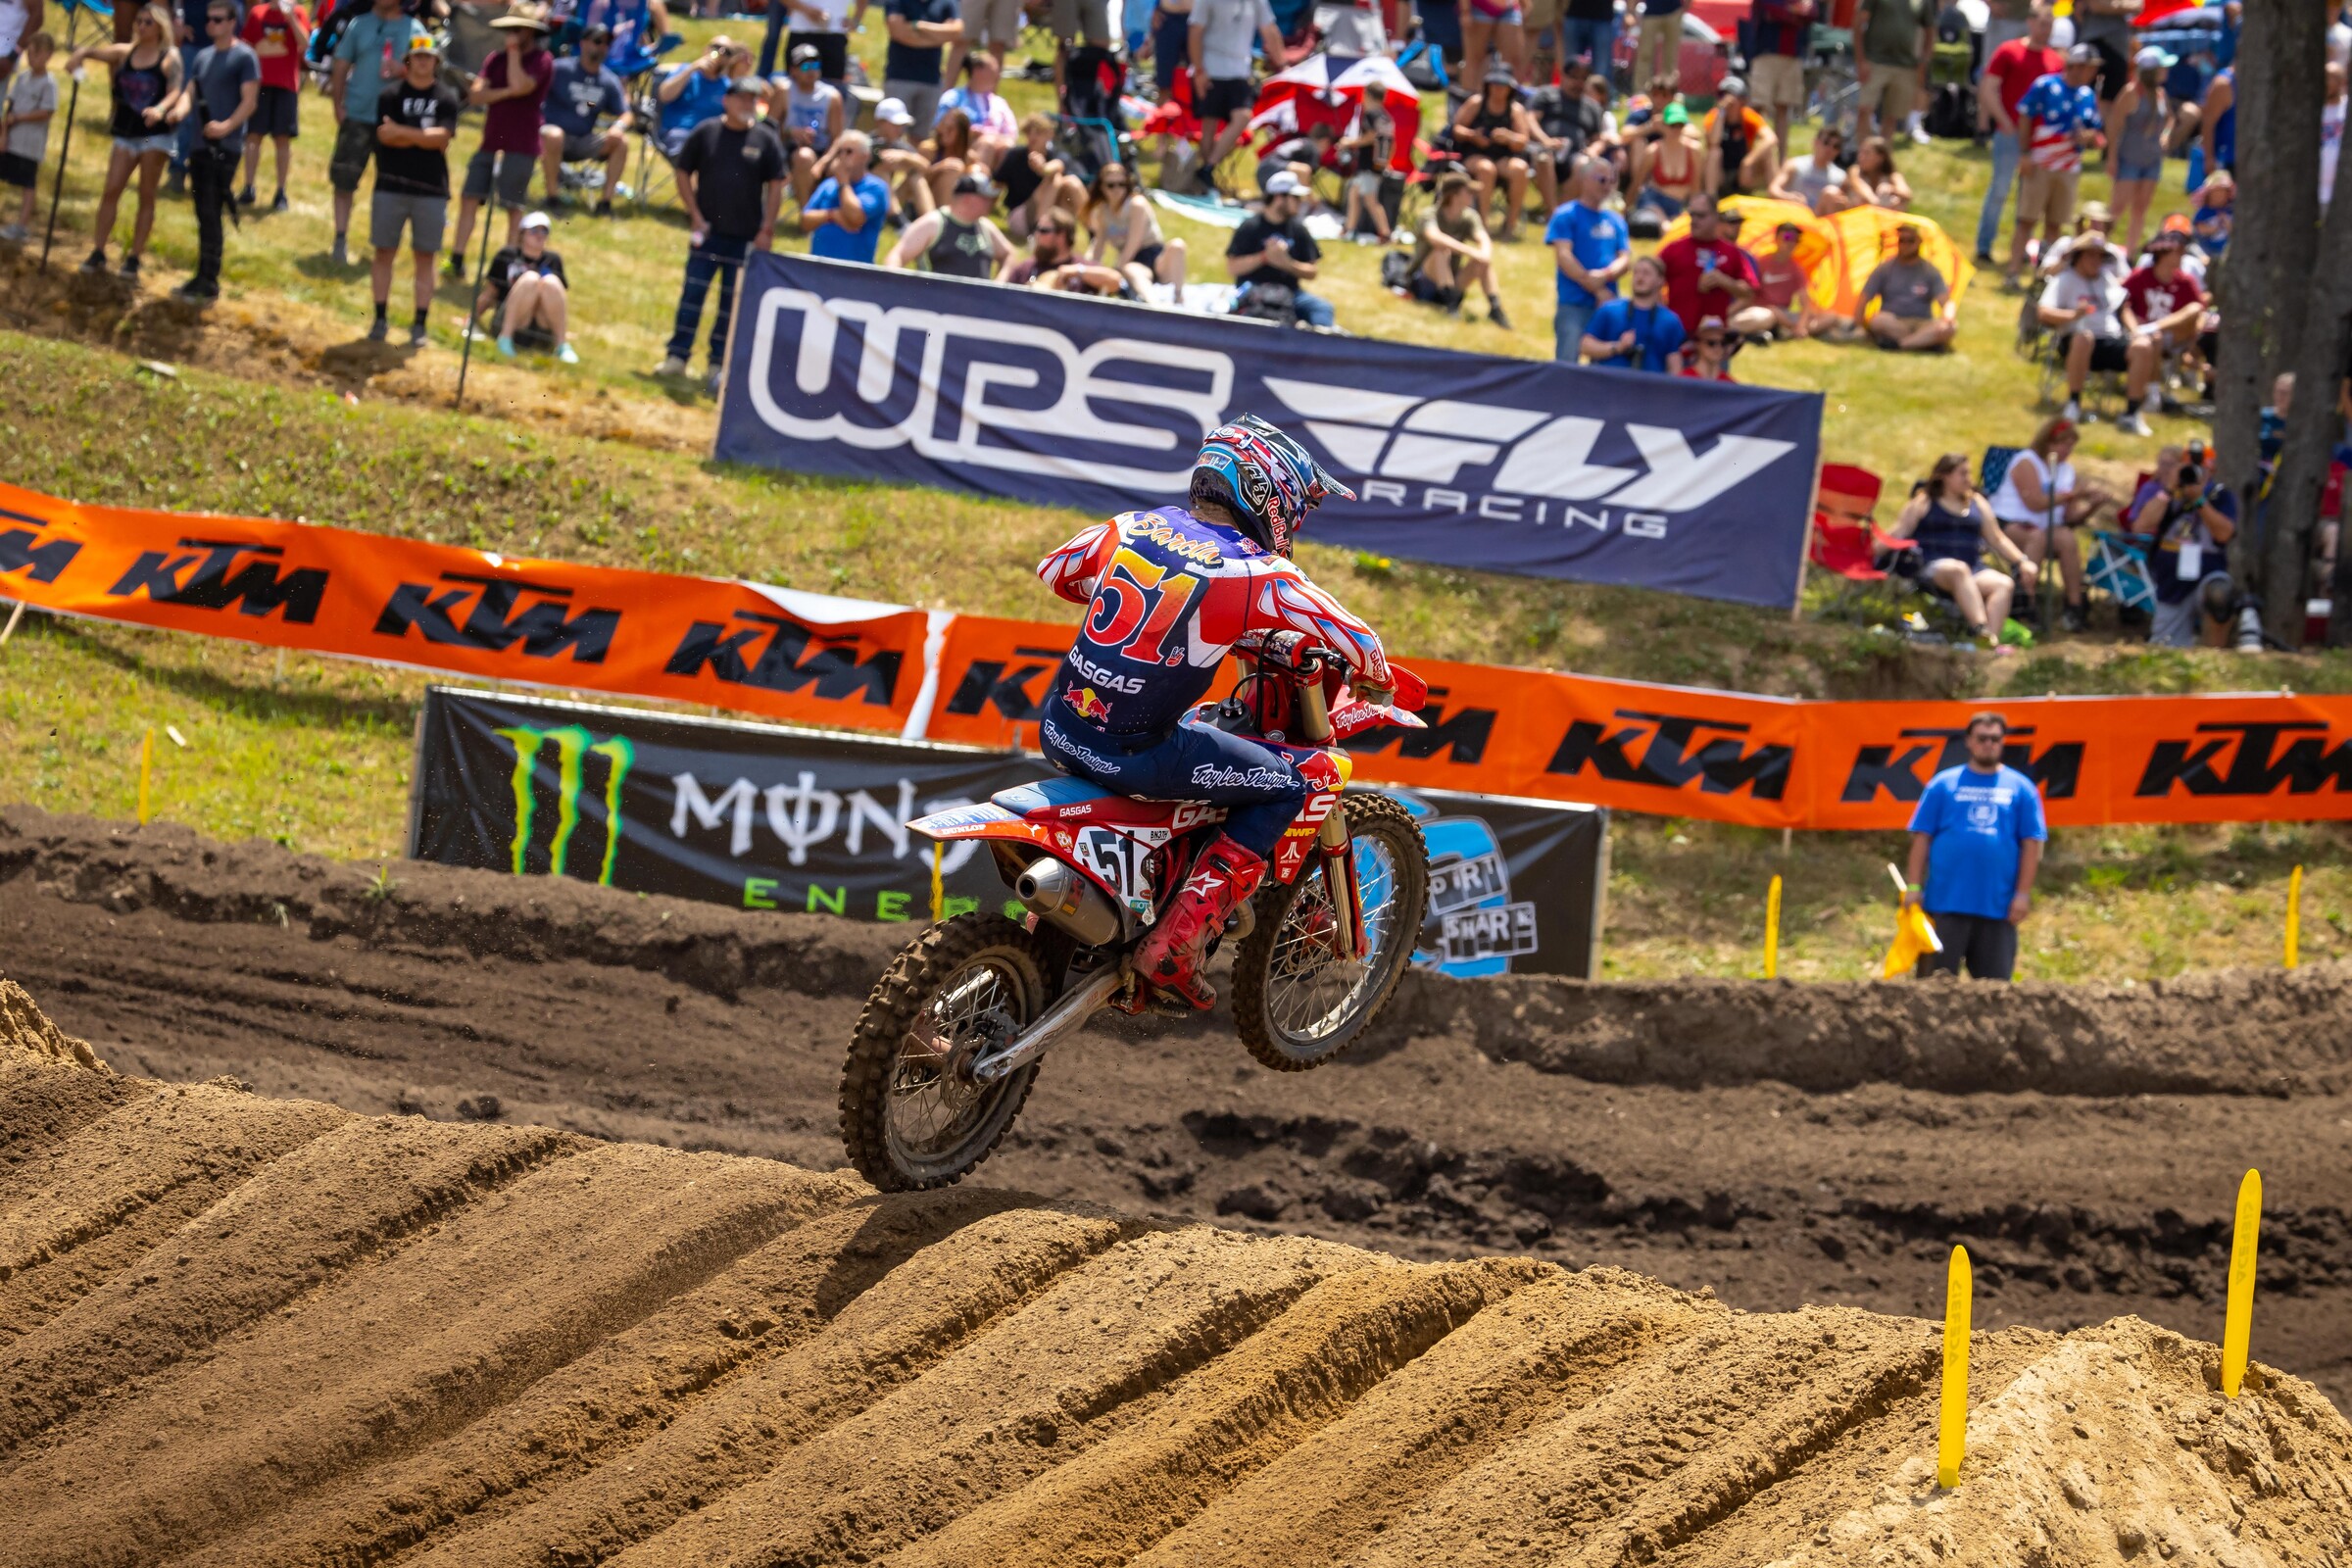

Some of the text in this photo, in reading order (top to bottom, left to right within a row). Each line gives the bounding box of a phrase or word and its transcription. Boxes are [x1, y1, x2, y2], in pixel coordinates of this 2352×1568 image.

[749, 287, 1234, 493] WPS
[1261, 376, 1796, 513] FLY
[1127, 513, 1224, 566] Barcia
[1362, 479, 1667, 540] RACING
[107, 537, 329, 624] KTM
[1084, 546, 1200, 664] 51
[372, 572, 622, 665] KTM
[664, 610, 905, 707] KTM
[1068, 645, 1146, 695] GASGAS
[1044, 719, 1059, 746] Troy
[1057, 734, 1076, 756] Lee
[1545, 710, 1795, 800] KTM
[2134, 721, 2352, 797] KTM
[1059, 805, 1092, 817] GASGAS
[1192, 763, 1300, 790] Troy Lee Designs
[942, 823, 986, 835] DUNLOP
[1089, 830, 1135, 897] 51
